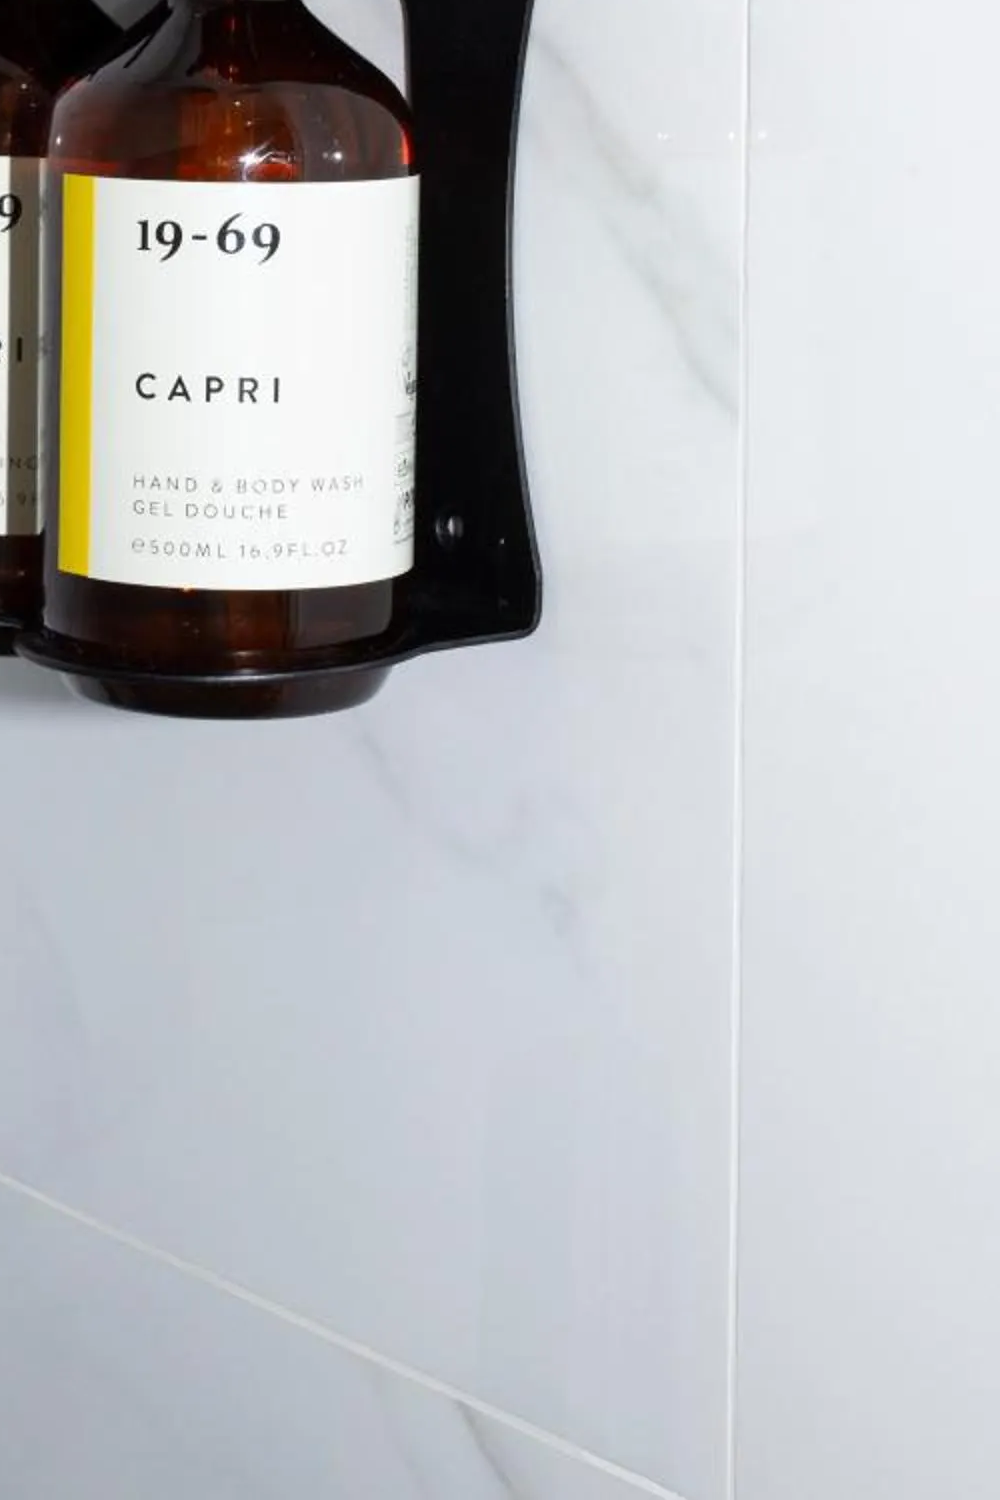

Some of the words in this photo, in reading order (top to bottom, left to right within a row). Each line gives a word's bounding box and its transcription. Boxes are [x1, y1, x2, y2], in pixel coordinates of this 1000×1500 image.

[136, 212, 281, 266] 19-69
[135, 372, 280, 404] CAPRI
[132, 475, 198, 493] HAND
[211, 479, 223, 494] &
[236, 478, 300, 495] BODY
[311, 474, 364, 493] WASH
[132, 499, 174, 518] GEL
[185, 502, 289, 520] DOUCHE
